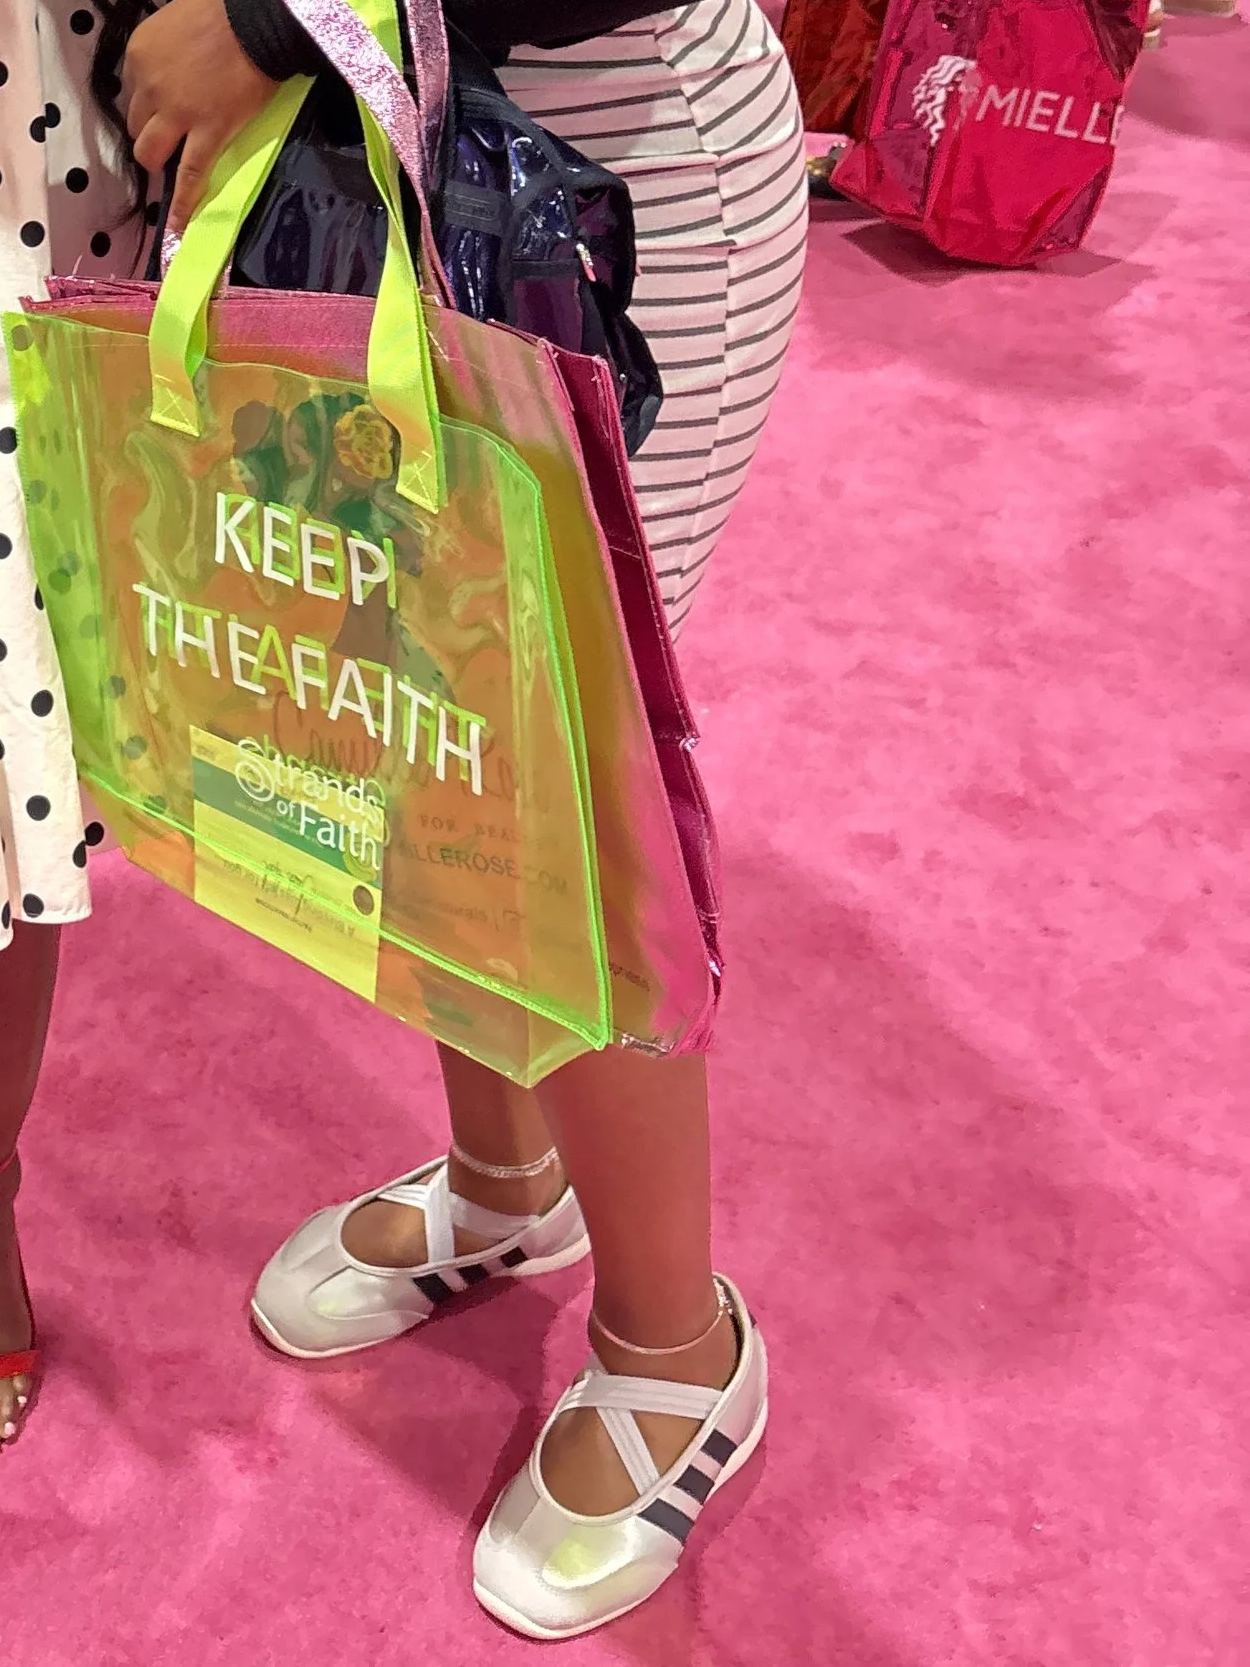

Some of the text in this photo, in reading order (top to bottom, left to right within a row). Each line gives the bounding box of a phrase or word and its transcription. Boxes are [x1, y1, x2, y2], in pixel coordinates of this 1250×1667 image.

[215, 492, 390, 606] KEEP
[291, 642, 483, 796] FAITH
[235, 738, 380, 825] Strands
[276, 798, 296, 818] of
[299, 800, 381, 871] Faith
